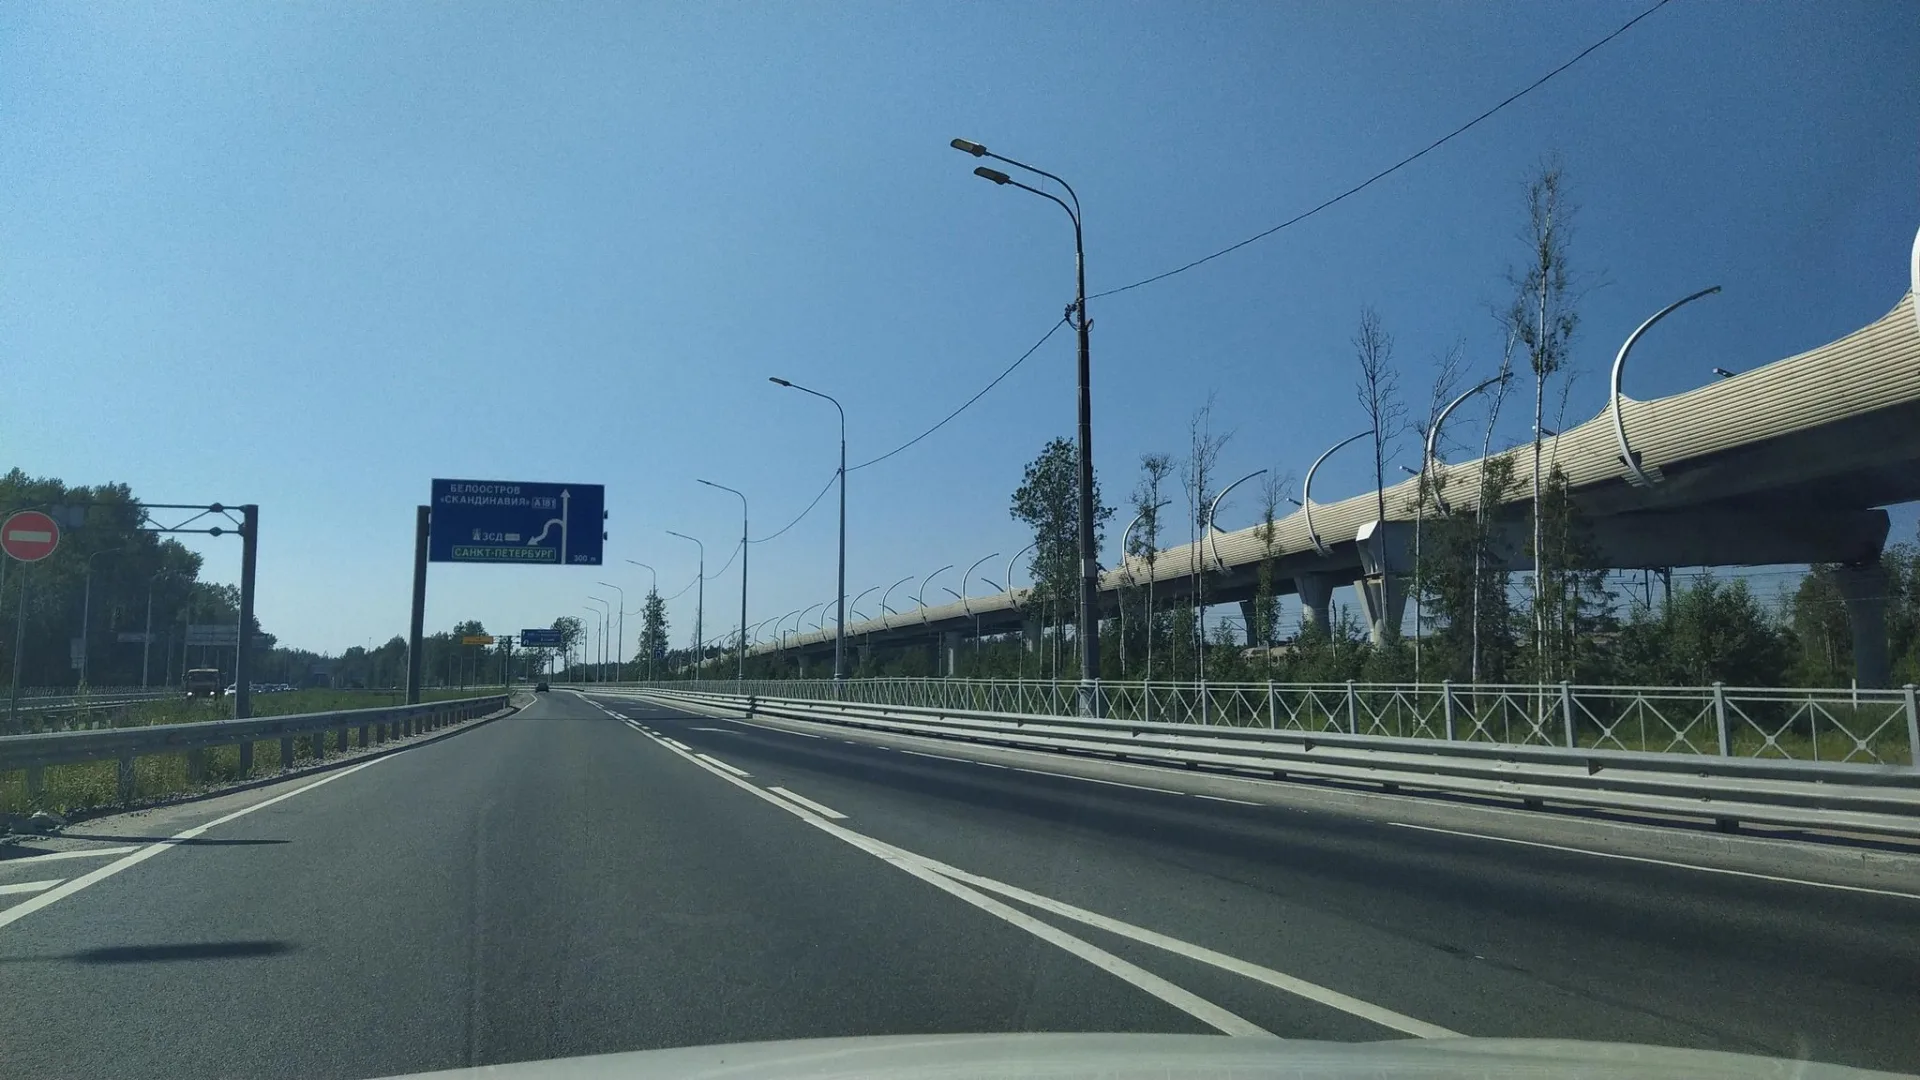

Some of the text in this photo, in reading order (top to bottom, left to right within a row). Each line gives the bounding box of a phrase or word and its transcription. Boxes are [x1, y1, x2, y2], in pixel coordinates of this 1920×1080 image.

[450, 484, 521, 495] БЕЛООСТРОВ
[482, 532, 503, 542] ЗСД
[454, 547, 554, 559] САНКТ-ПЕТЕРБУРГ
[573, 554, 588, 562] 300
